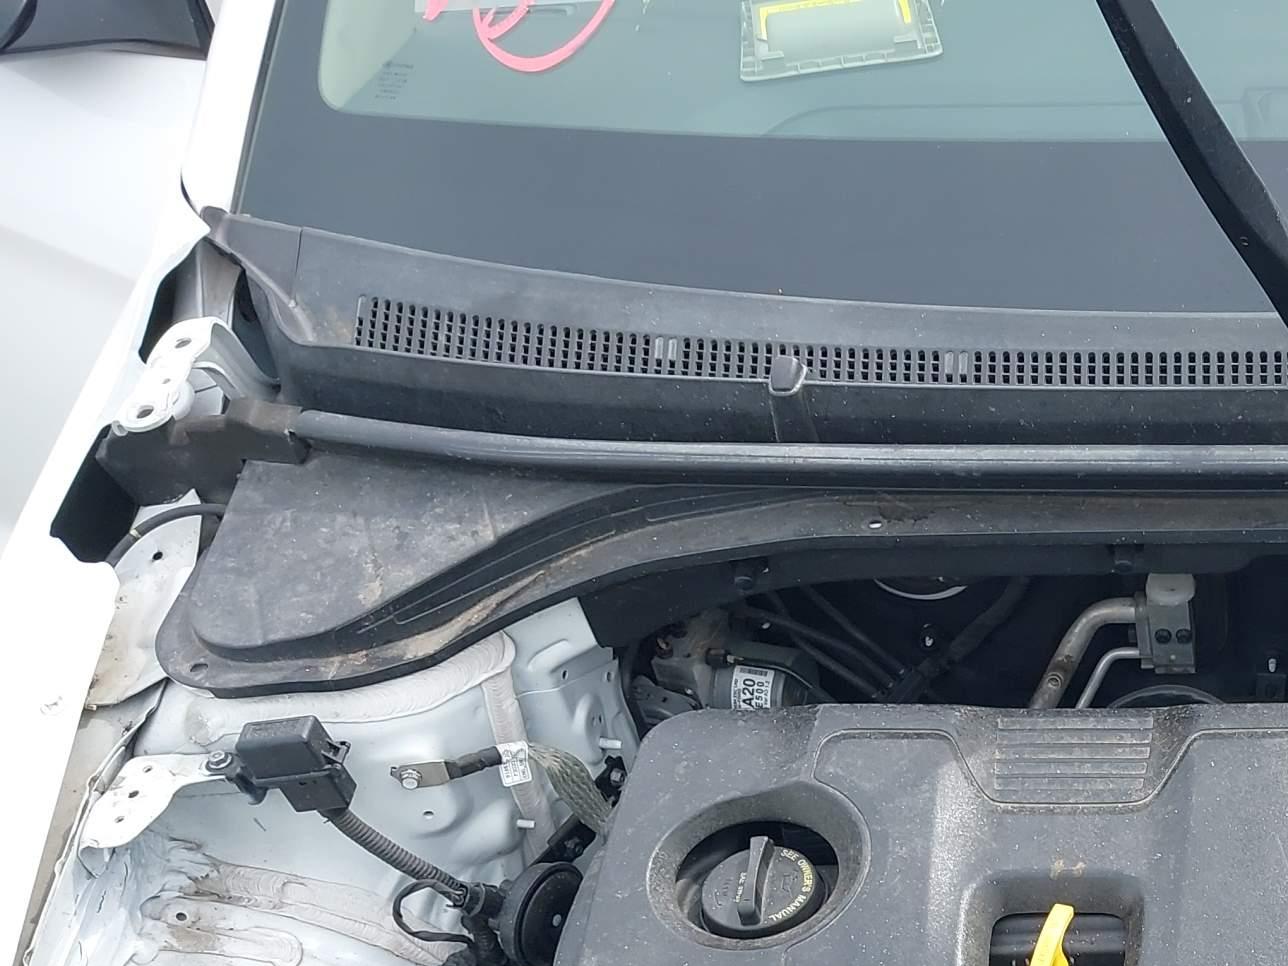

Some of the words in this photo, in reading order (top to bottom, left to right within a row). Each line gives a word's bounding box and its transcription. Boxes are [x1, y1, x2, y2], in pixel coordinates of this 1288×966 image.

[780, 848, 800, 862] SEE
[797, 859, 813, 893] OWNER'S
[768, 894, 807, 921] MANUAL
